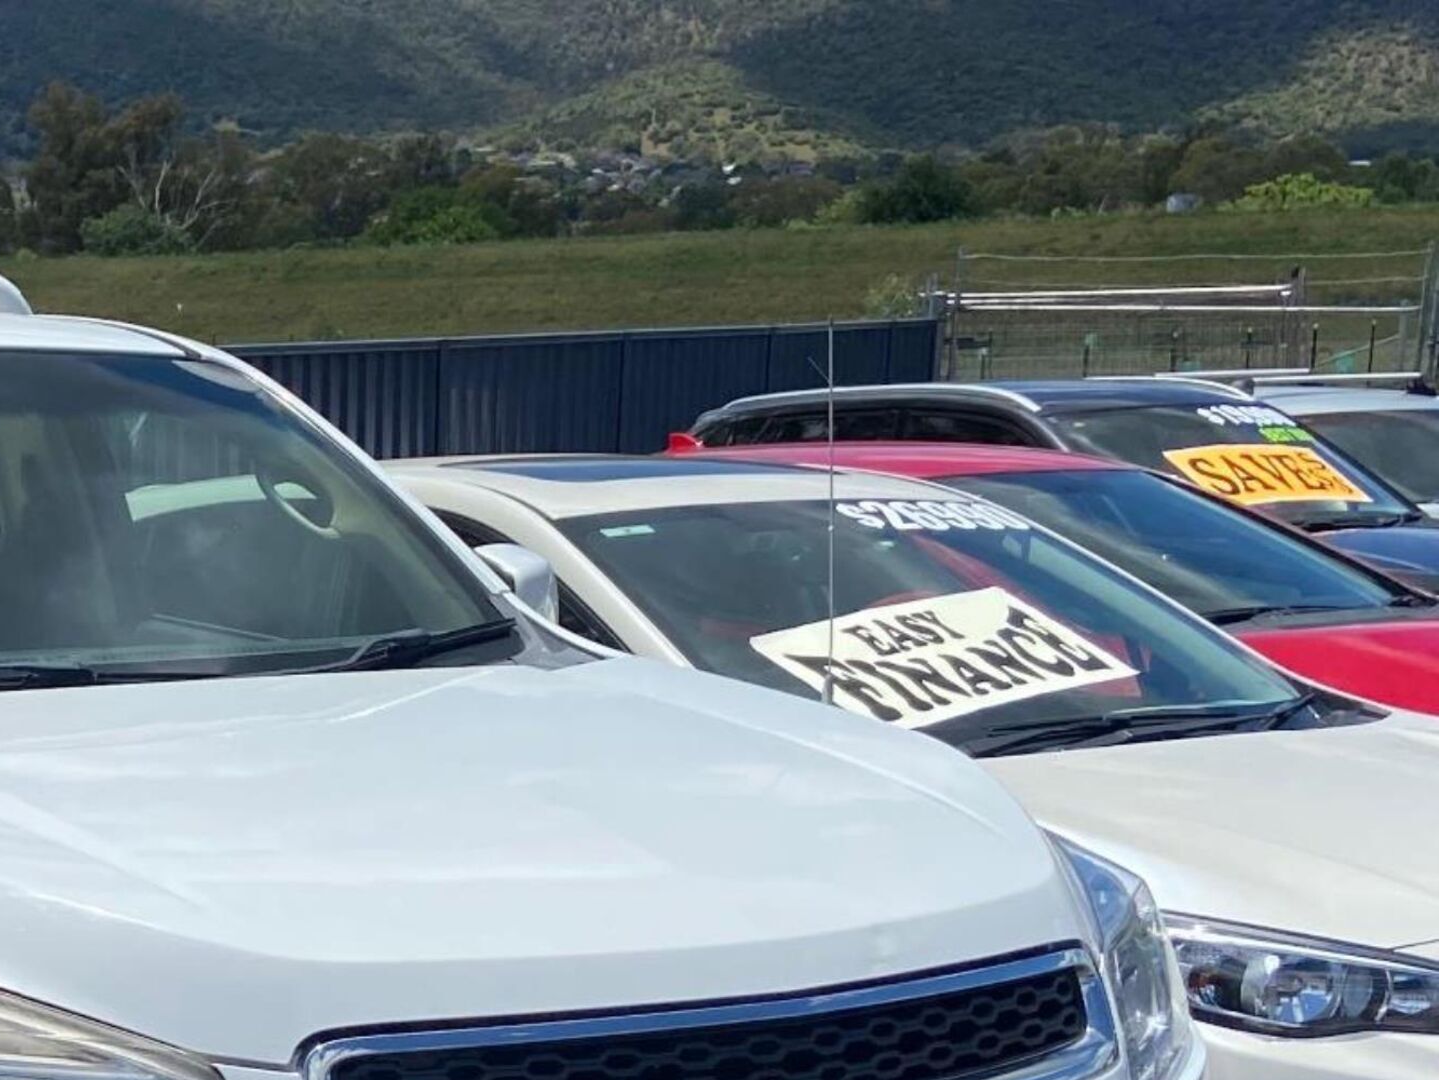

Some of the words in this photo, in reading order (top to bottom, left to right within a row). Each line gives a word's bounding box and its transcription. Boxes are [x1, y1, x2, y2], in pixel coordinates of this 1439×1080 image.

[1188, 454, 1327, 495] SAVE
[843, 610, 965, 657] EASY
[783, 605, 1115, 721] FINANCE
